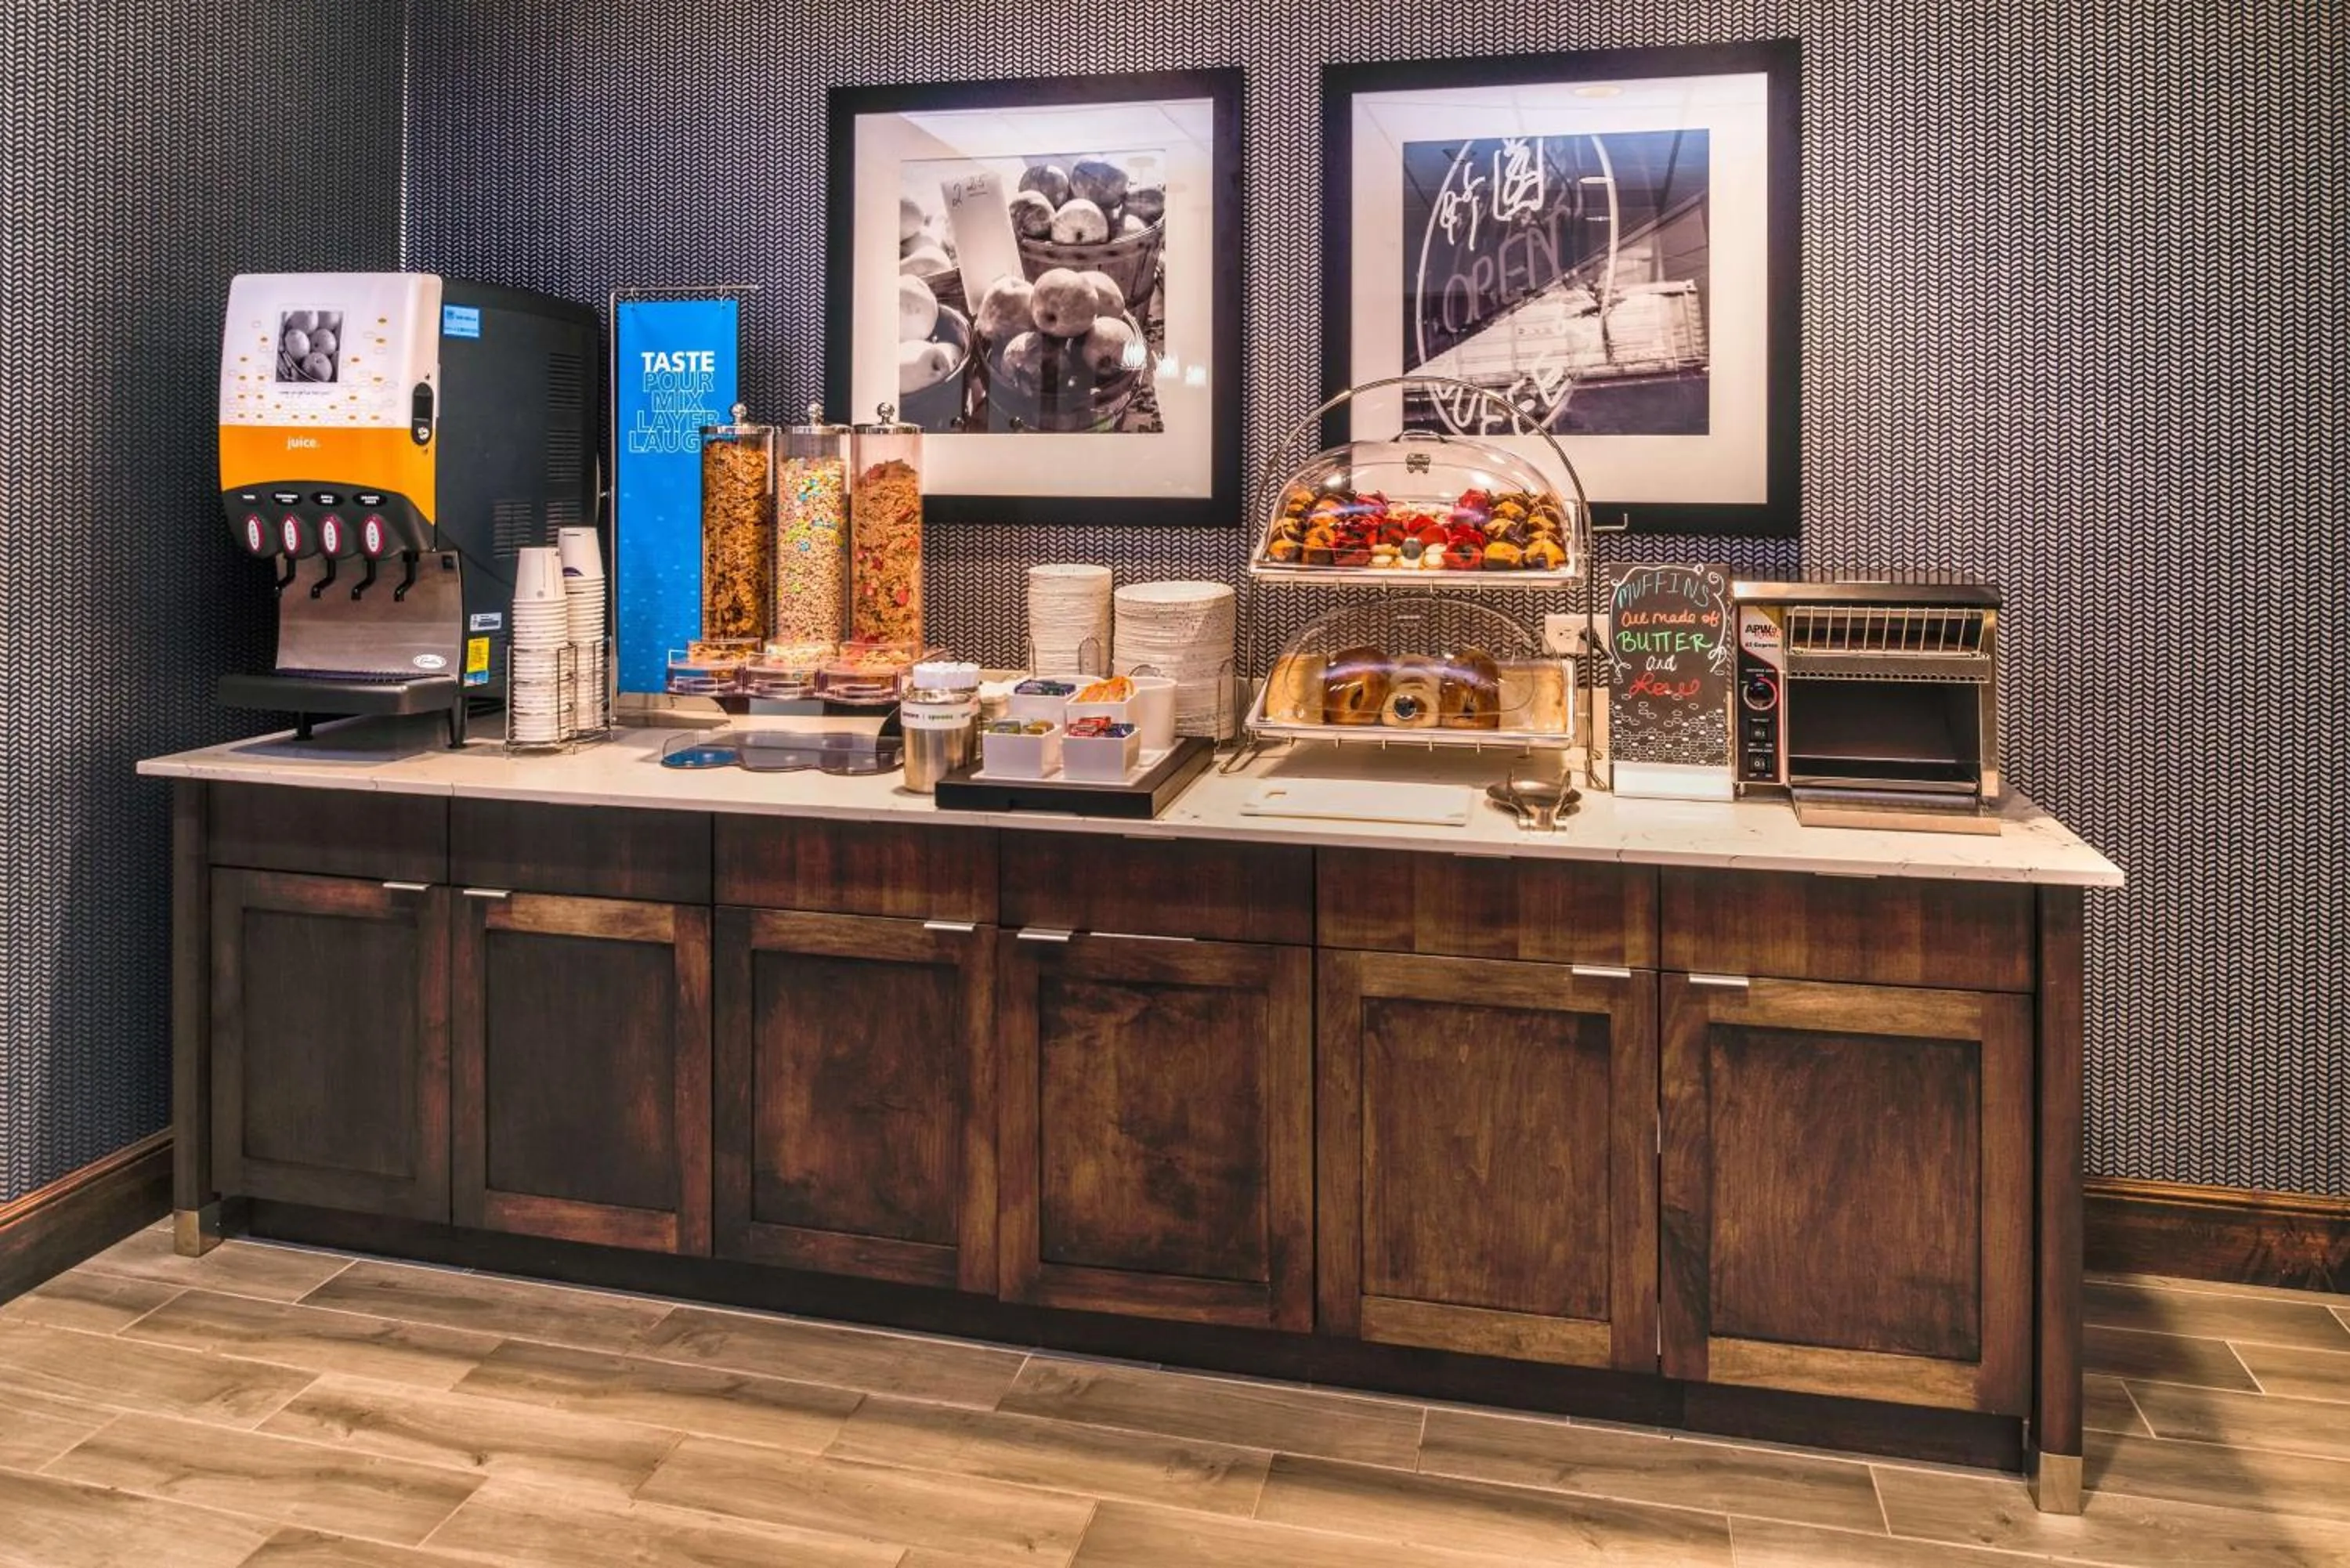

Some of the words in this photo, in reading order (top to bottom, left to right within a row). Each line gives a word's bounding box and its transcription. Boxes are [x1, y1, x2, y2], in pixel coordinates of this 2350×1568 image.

[641, 351, 715, 372] TASTE
[642, 370, 714, 392] POUR
[651, 390, 704, 412] MIX
[636, 410, 719, 432] LAYER
[628, 430, 702, 453] LAUG
[1617, 572, 1709, 609] MUFFINS
[1651, 609, 1696, 626] made
[1701, 610, 1721, 628] of
[1616, 630, 1714, 652] BUTTER
[1646, 654, 1678, 673] and
